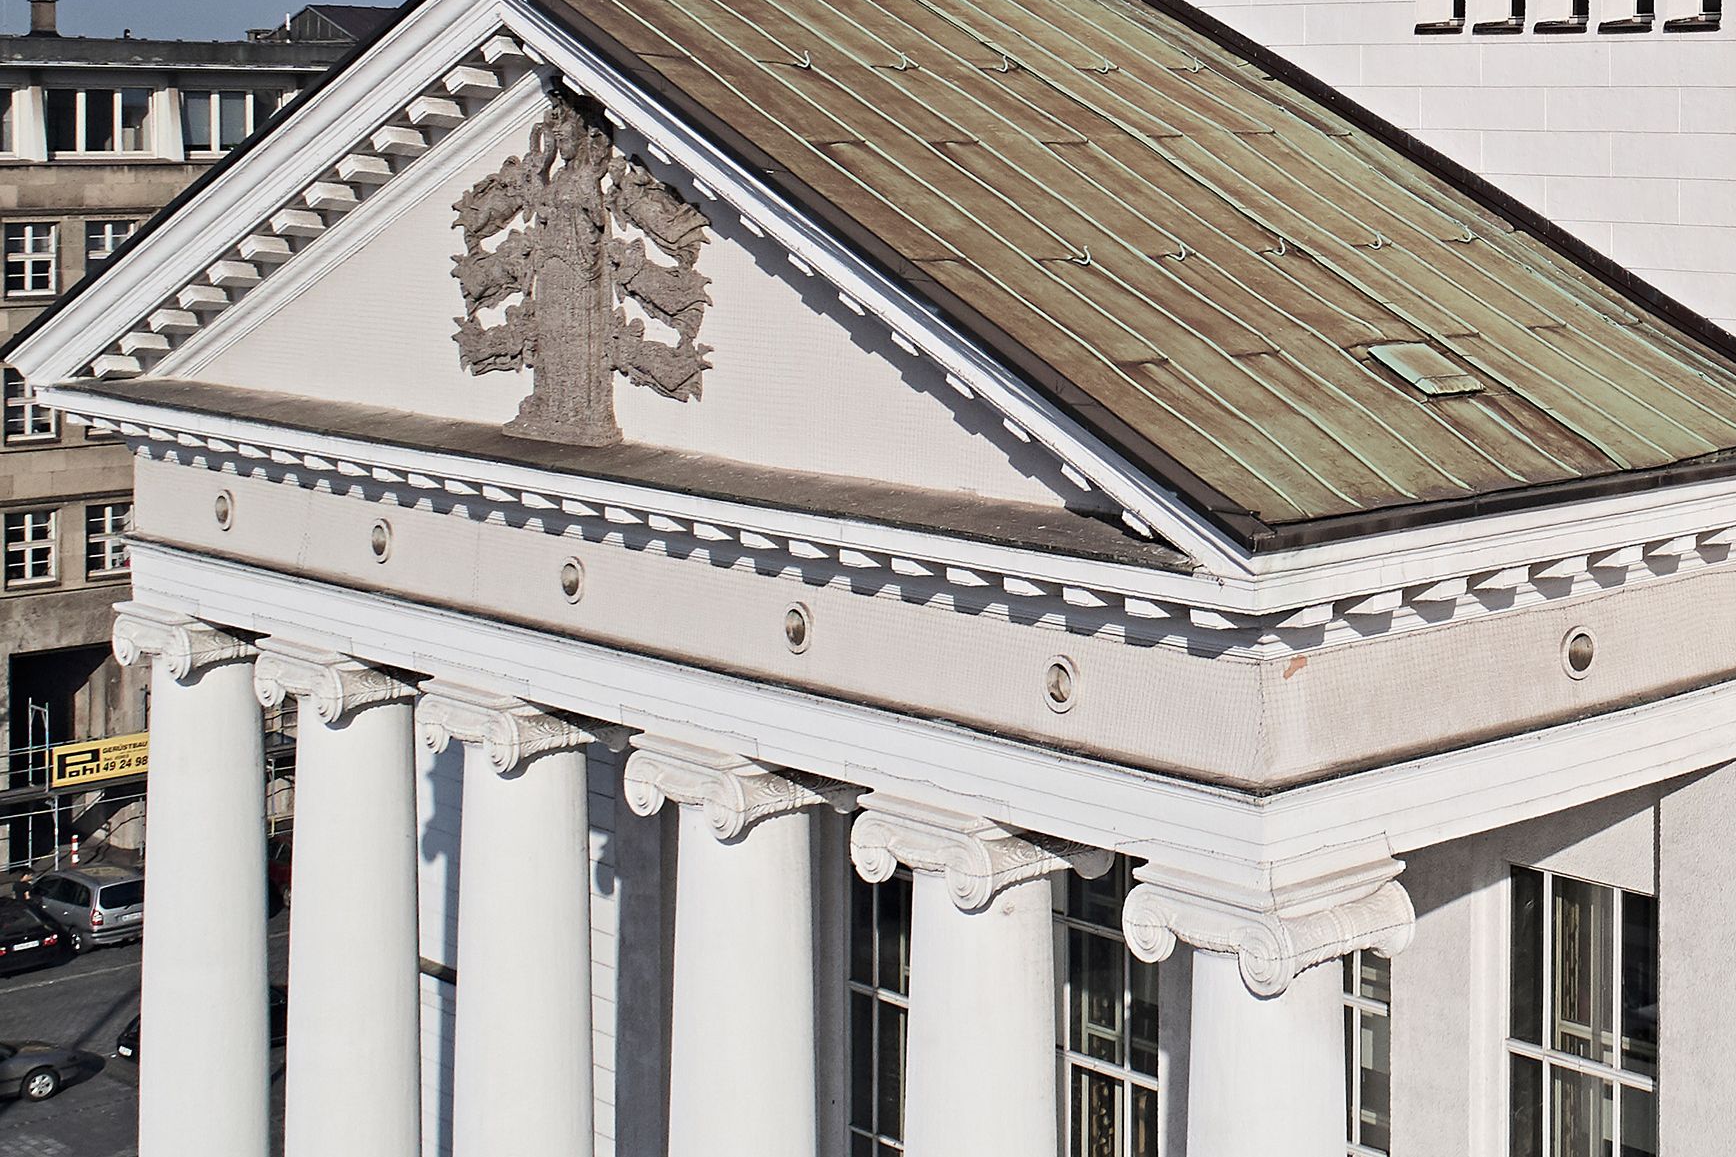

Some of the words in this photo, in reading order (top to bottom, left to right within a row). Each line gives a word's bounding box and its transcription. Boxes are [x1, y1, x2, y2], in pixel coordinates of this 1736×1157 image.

[102, 741, 147, 753] GERÜSTBAU
[57, 748, 100, 779] Pohl
[103, 762, 116, 772] 49
[120, 758, 131, 769] 24
